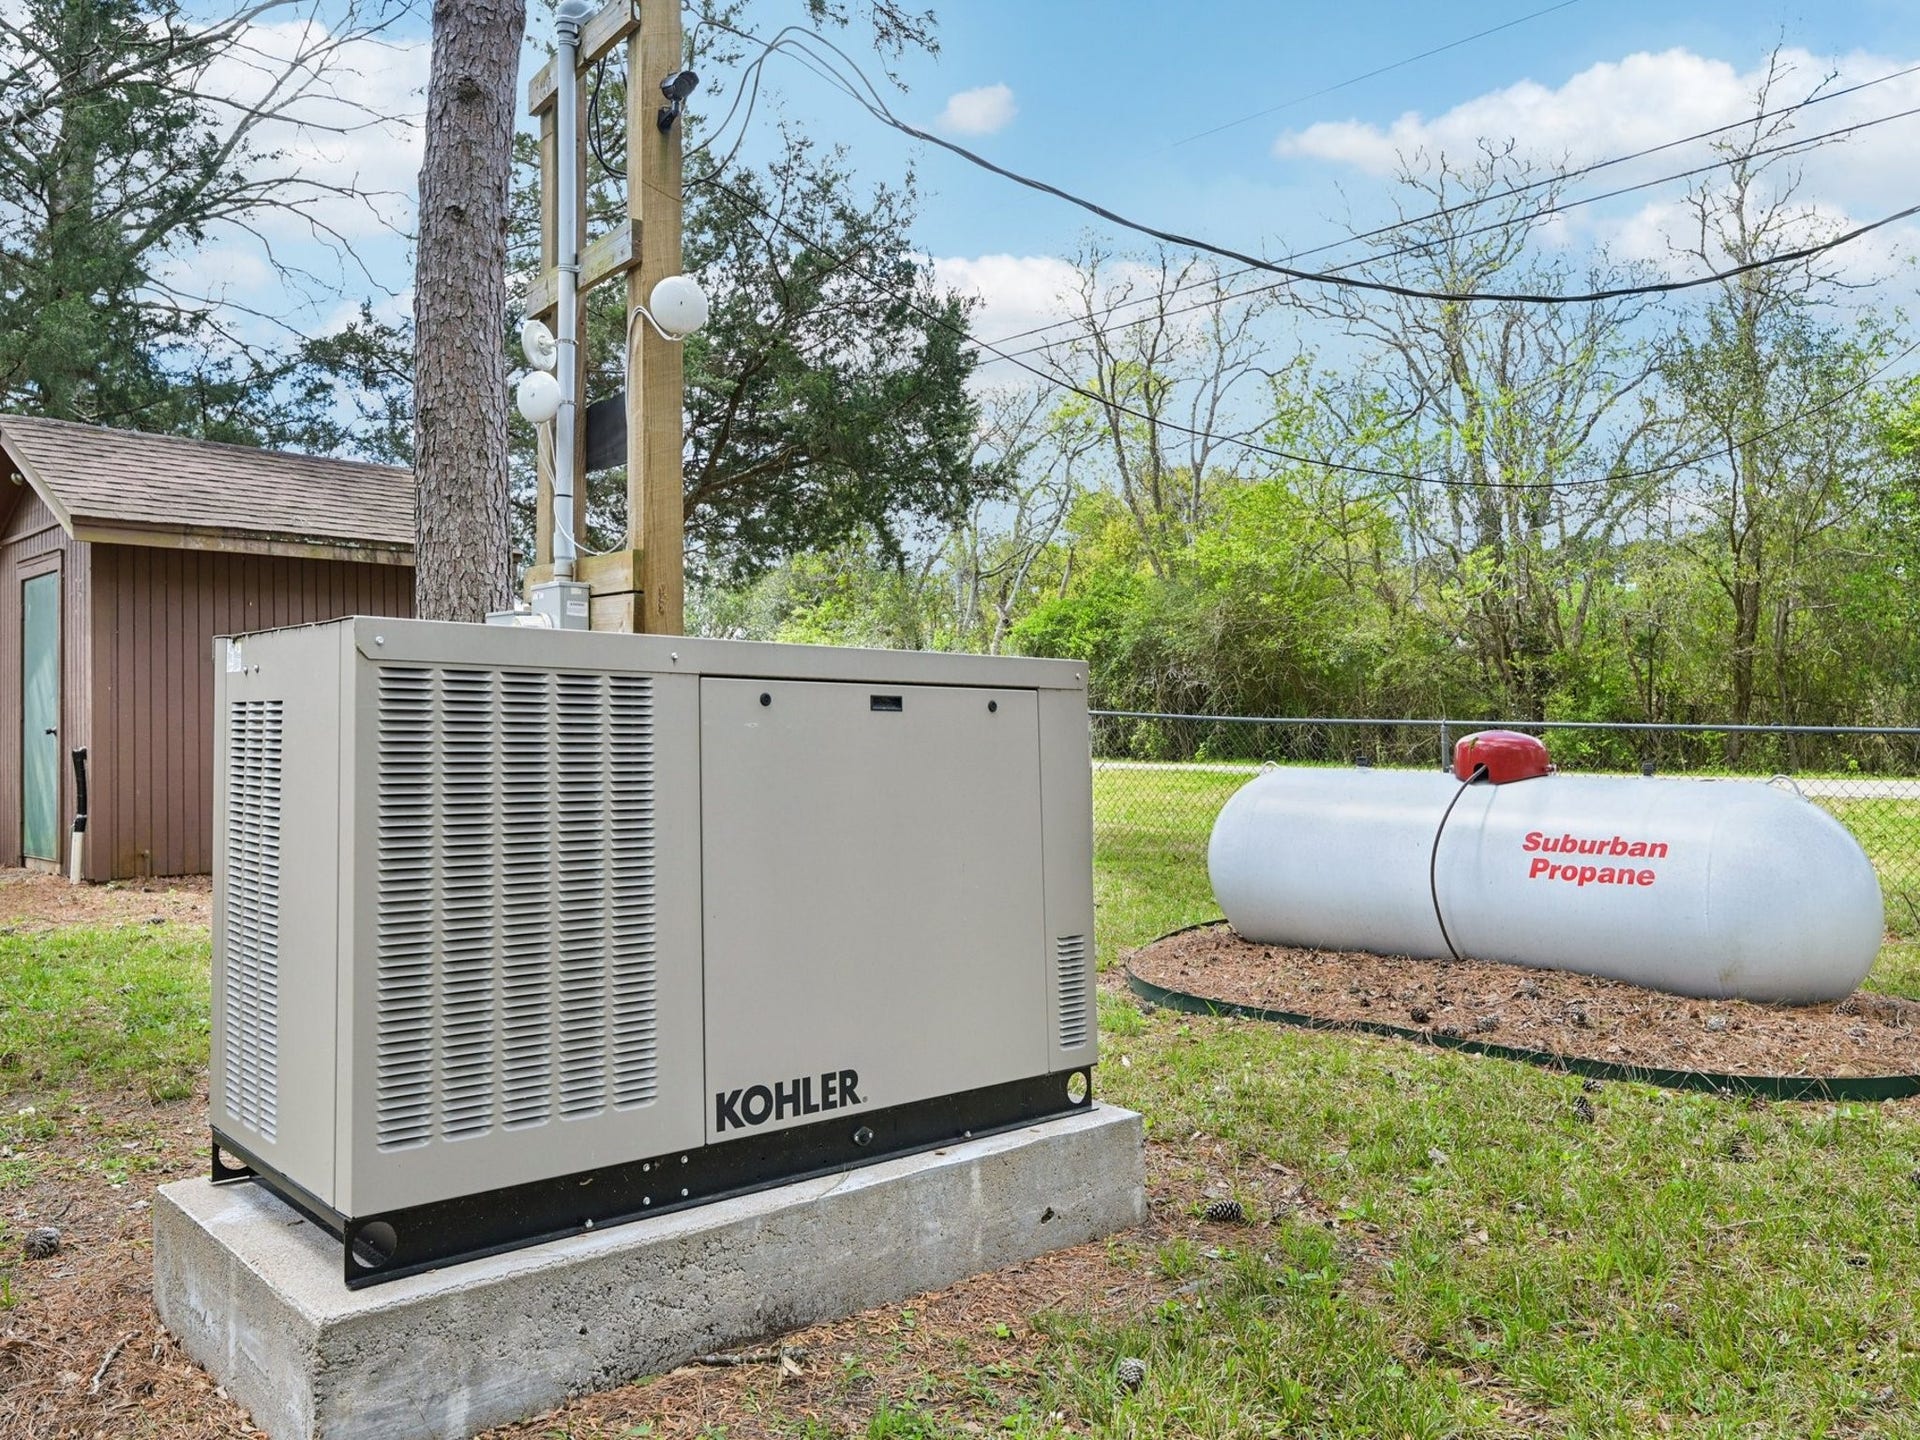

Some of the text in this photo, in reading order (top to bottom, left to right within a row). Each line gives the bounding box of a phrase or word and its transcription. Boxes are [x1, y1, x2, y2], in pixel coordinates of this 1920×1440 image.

[1522, 832, 1669, 858] Suburban
[1529, 858, 1656, 886] Propane
[716, 1069, 862, 1132] KOHLER
